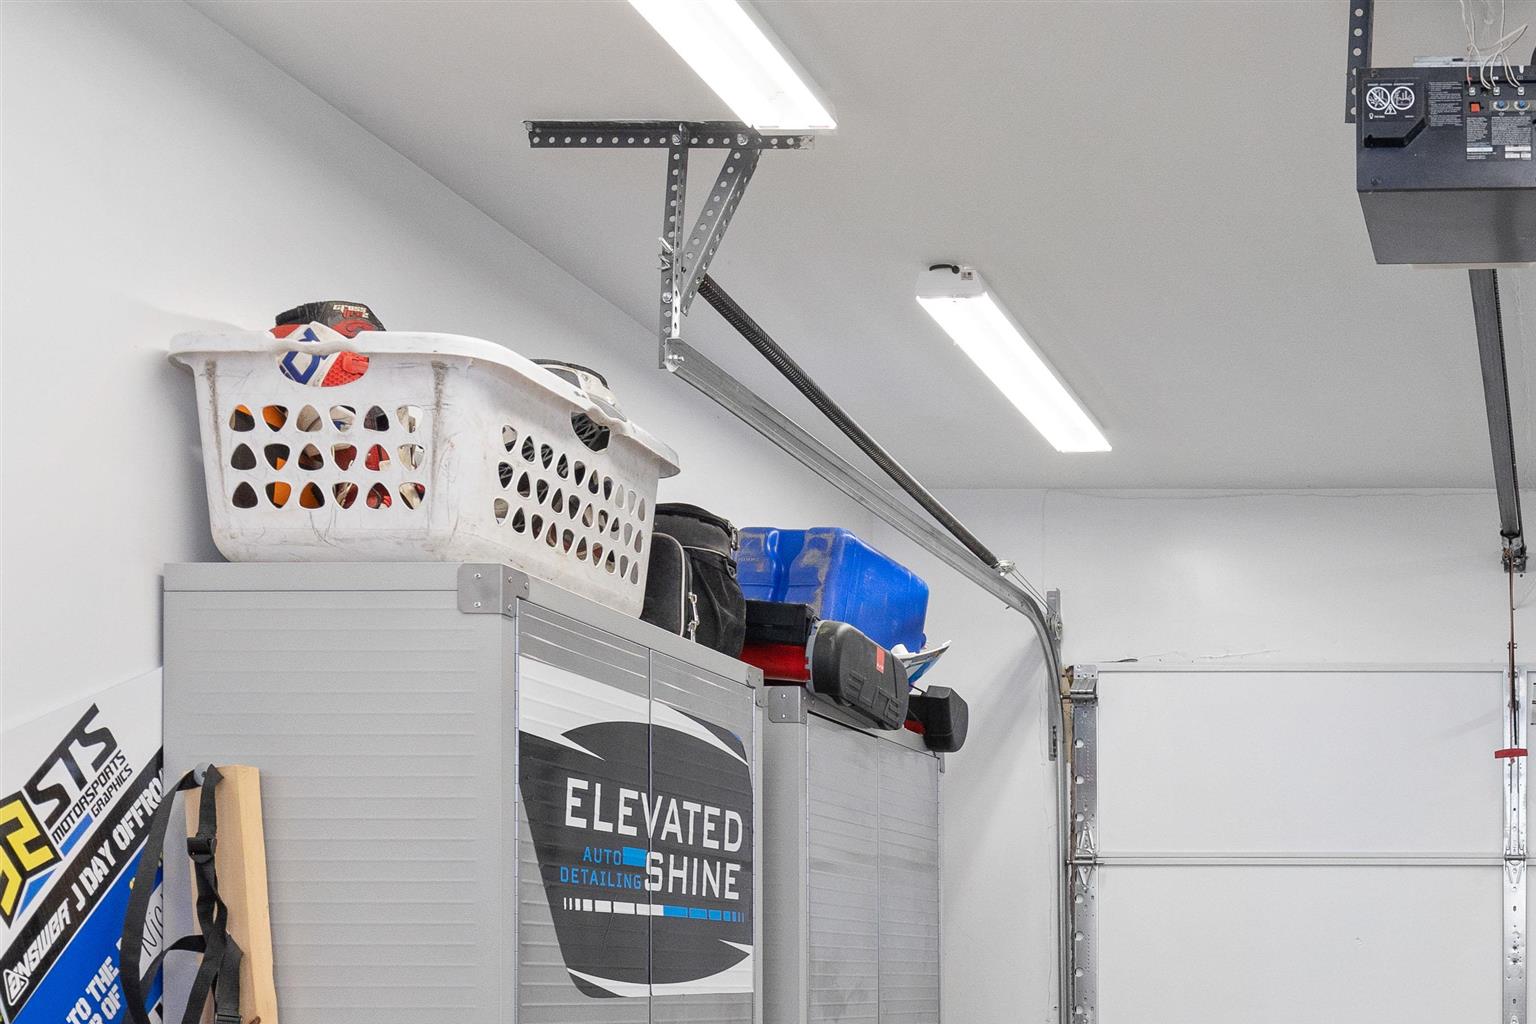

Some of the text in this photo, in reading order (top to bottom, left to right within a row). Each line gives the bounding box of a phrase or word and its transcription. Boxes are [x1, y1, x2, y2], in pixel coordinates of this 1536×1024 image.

[23, 702, 118, 831] STS
[91, 763, 134, 818] GRAPHICS
[51, 749, 127, 845] MOTORSPORTS
[565, 776, 743, 852] ELEVATED
[77, 838, 118, 897] DAY
[560, 866, 642, 890] DETAILING
[582, 846, 622, 865] AUTO
[644, 850, 741, 900] SHINE
[70, 882, 86, 912] J
[85, 955, 120, 1002] THE
[100, 983, 121, 1020] OF
